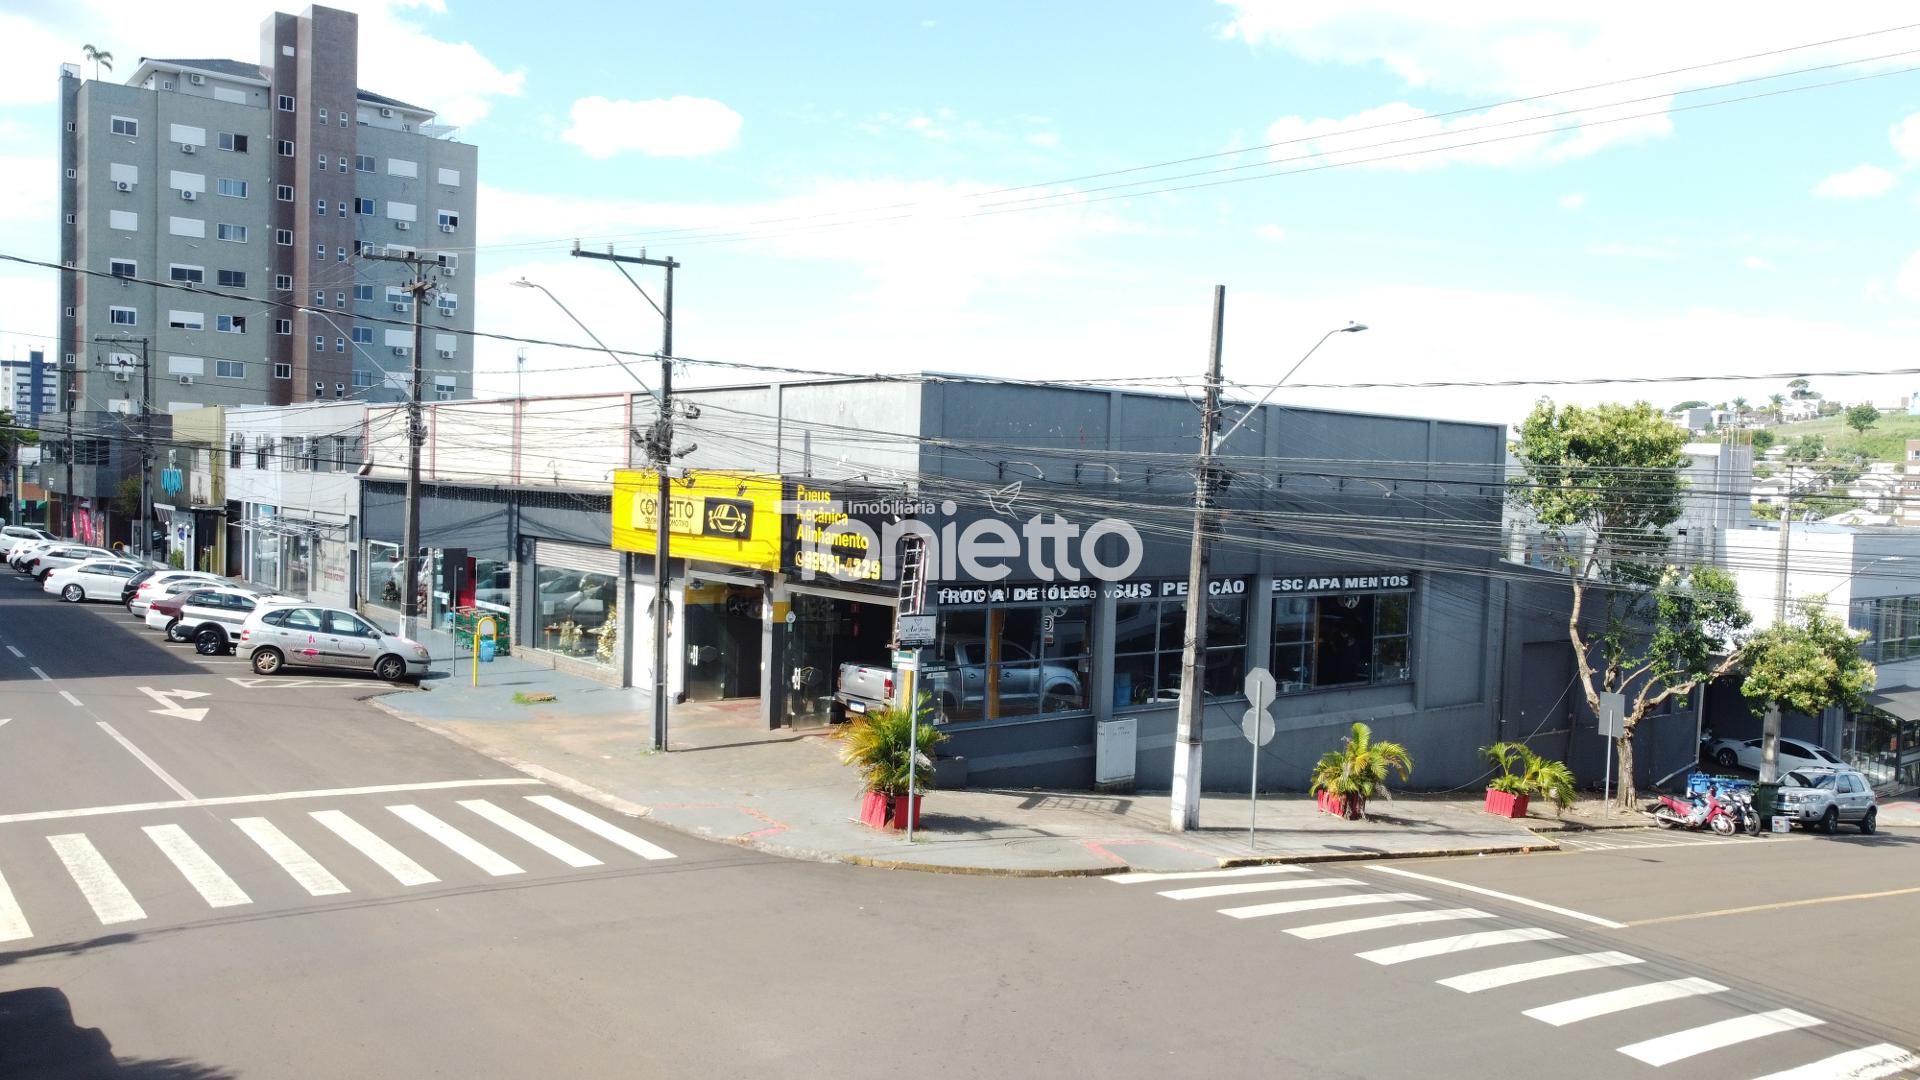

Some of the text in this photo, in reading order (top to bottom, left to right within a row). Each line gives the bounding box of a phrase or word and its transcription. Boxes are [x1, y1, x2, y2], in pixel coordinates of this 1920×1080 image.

[640, 499, 694, 518] COEITO
[796, 524, 870, 549] Alinhamento
[1013, 588, 1038, 601] DE
